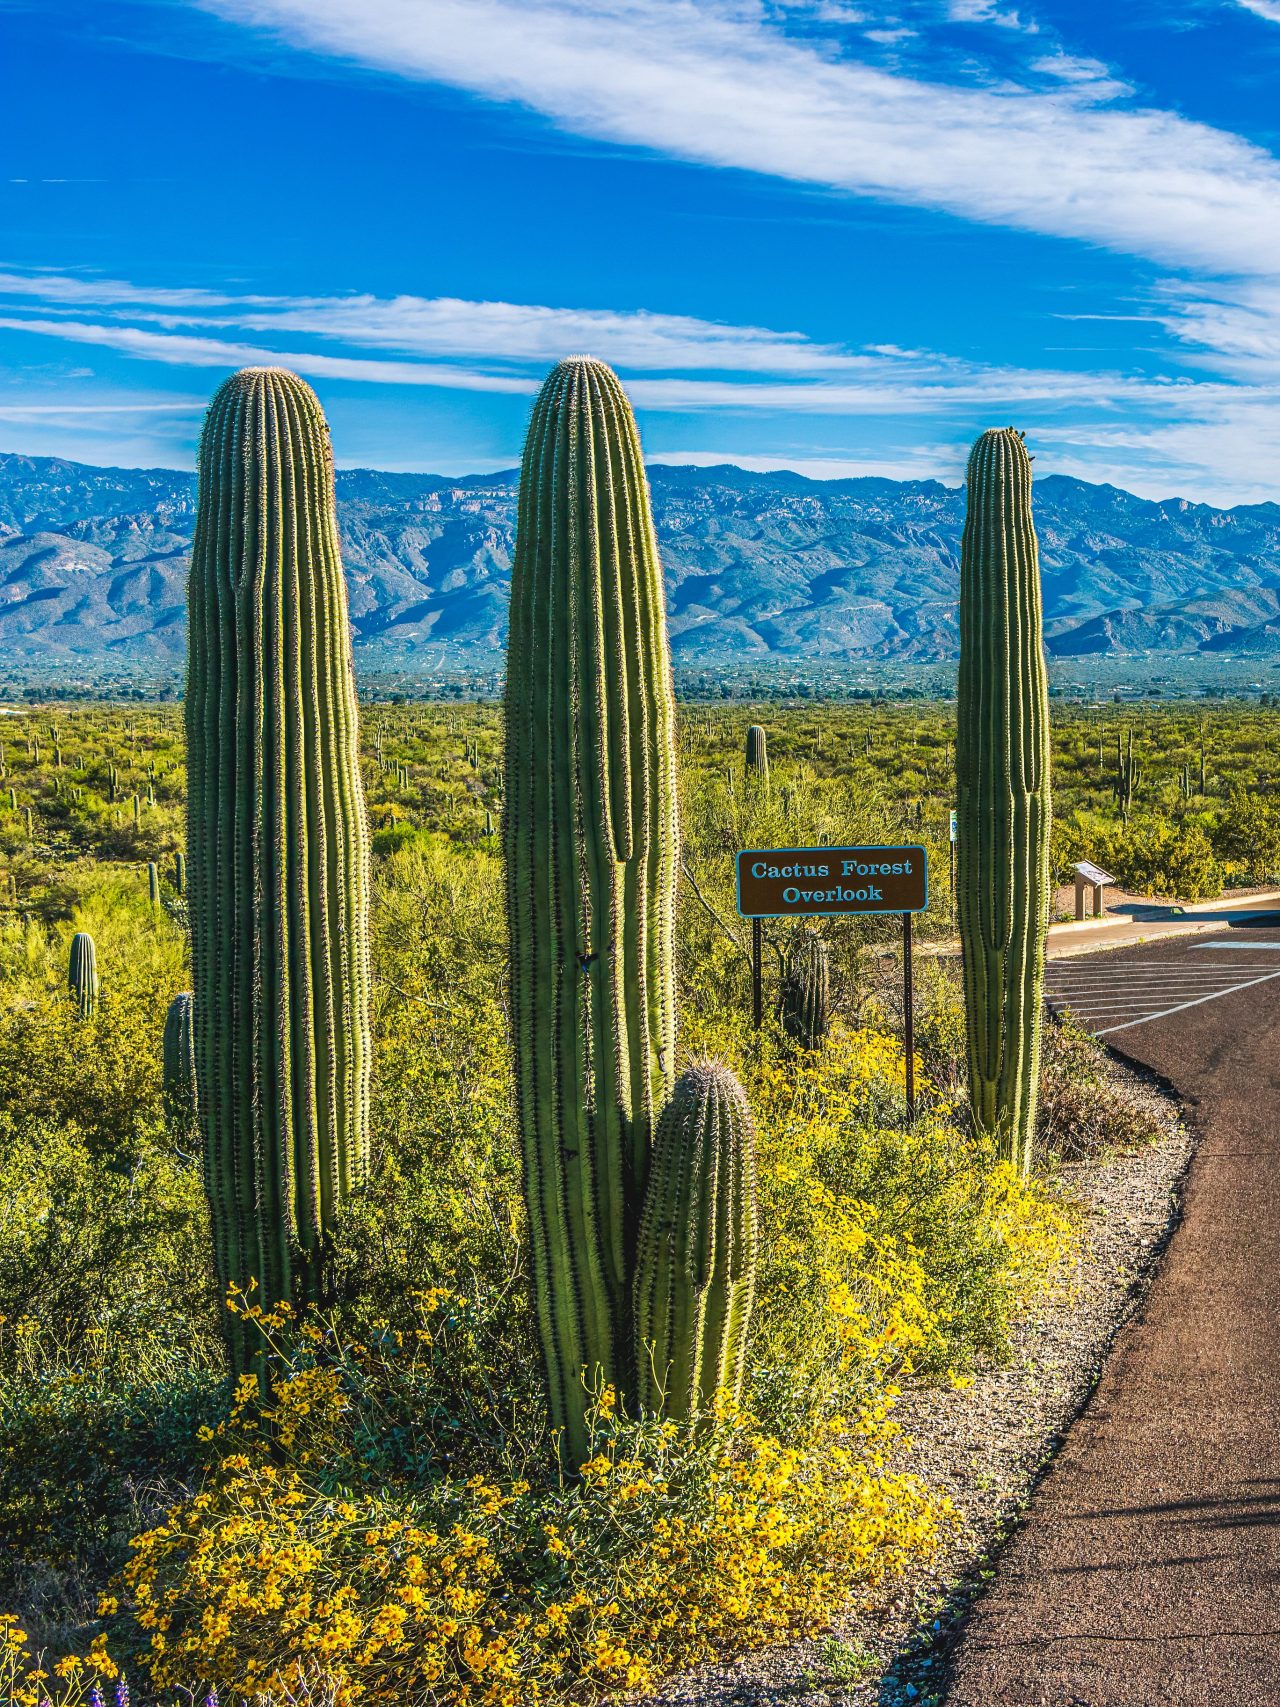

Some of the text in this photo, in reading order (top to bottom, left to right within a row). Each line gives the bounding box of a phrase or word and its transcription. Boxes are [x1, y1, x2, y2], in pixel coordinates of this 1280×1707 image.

[751, 859, 913, 879] Cactus Forest
[782, 885, 883, 904] Overlook
